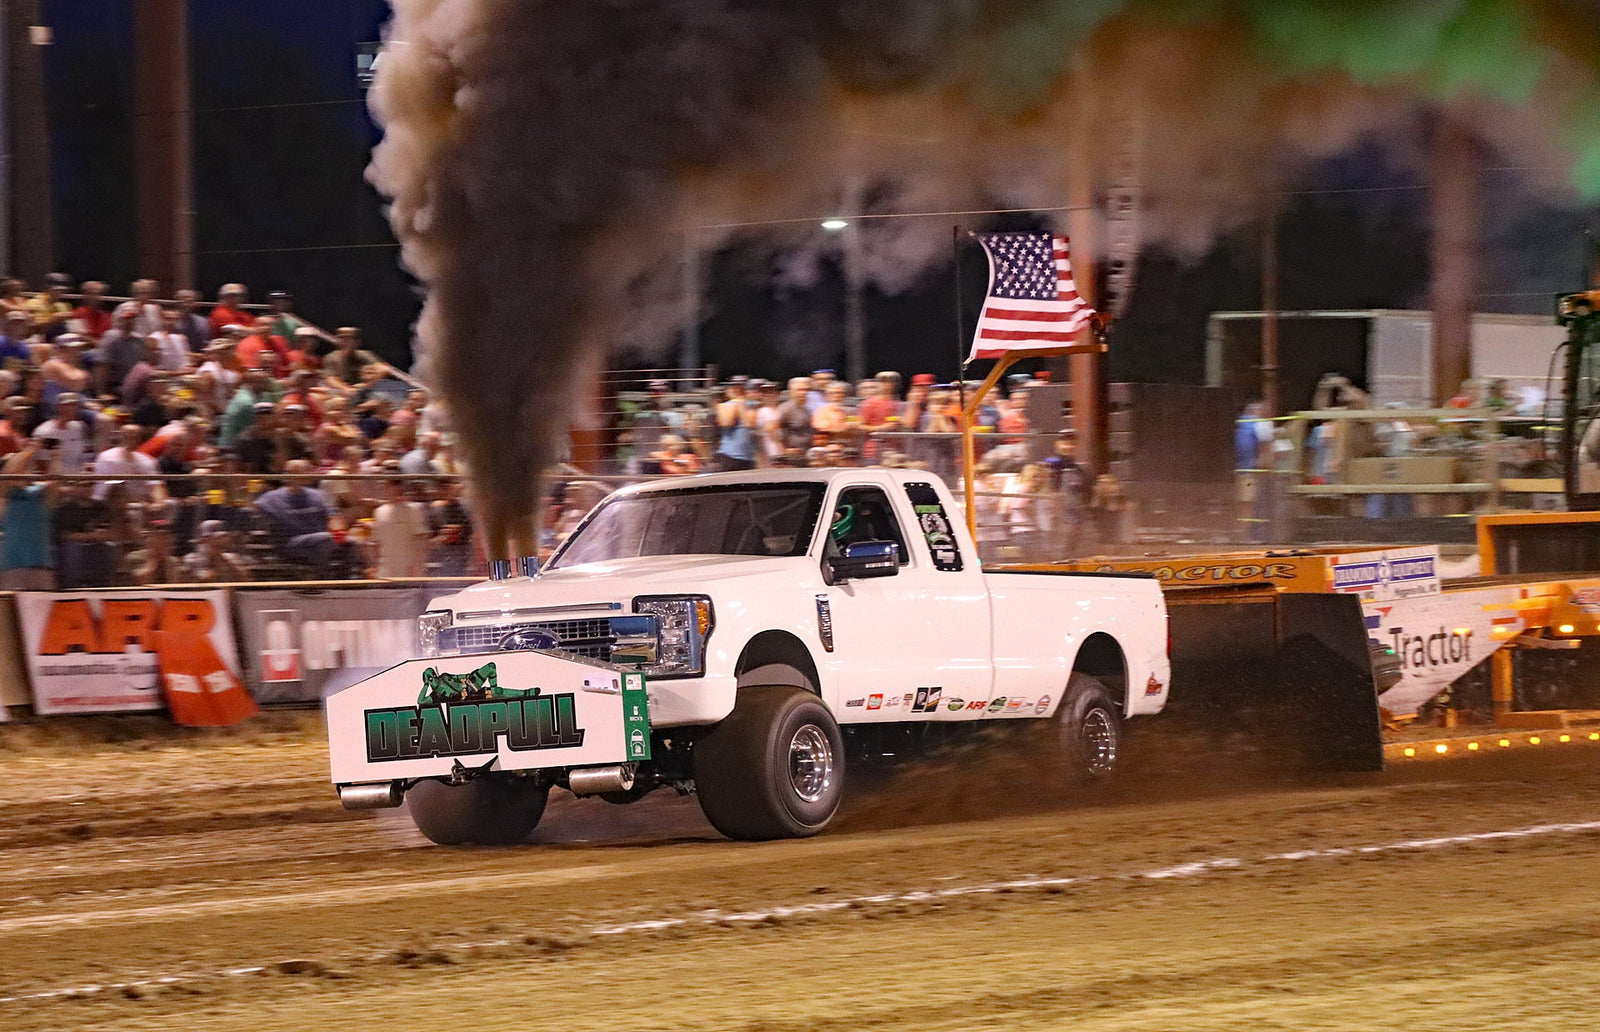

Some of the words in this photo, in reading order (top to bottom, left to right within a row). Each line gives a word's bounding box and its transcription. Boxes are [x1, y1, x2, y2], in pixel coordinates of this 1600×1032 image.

[1335, 566, 1375, 584] DIAMOND
[513, 635, 541, 650] Ford
[1389, 626, 1473, 669] Tractor
[364, 692, 585, 763] DEADPULL
